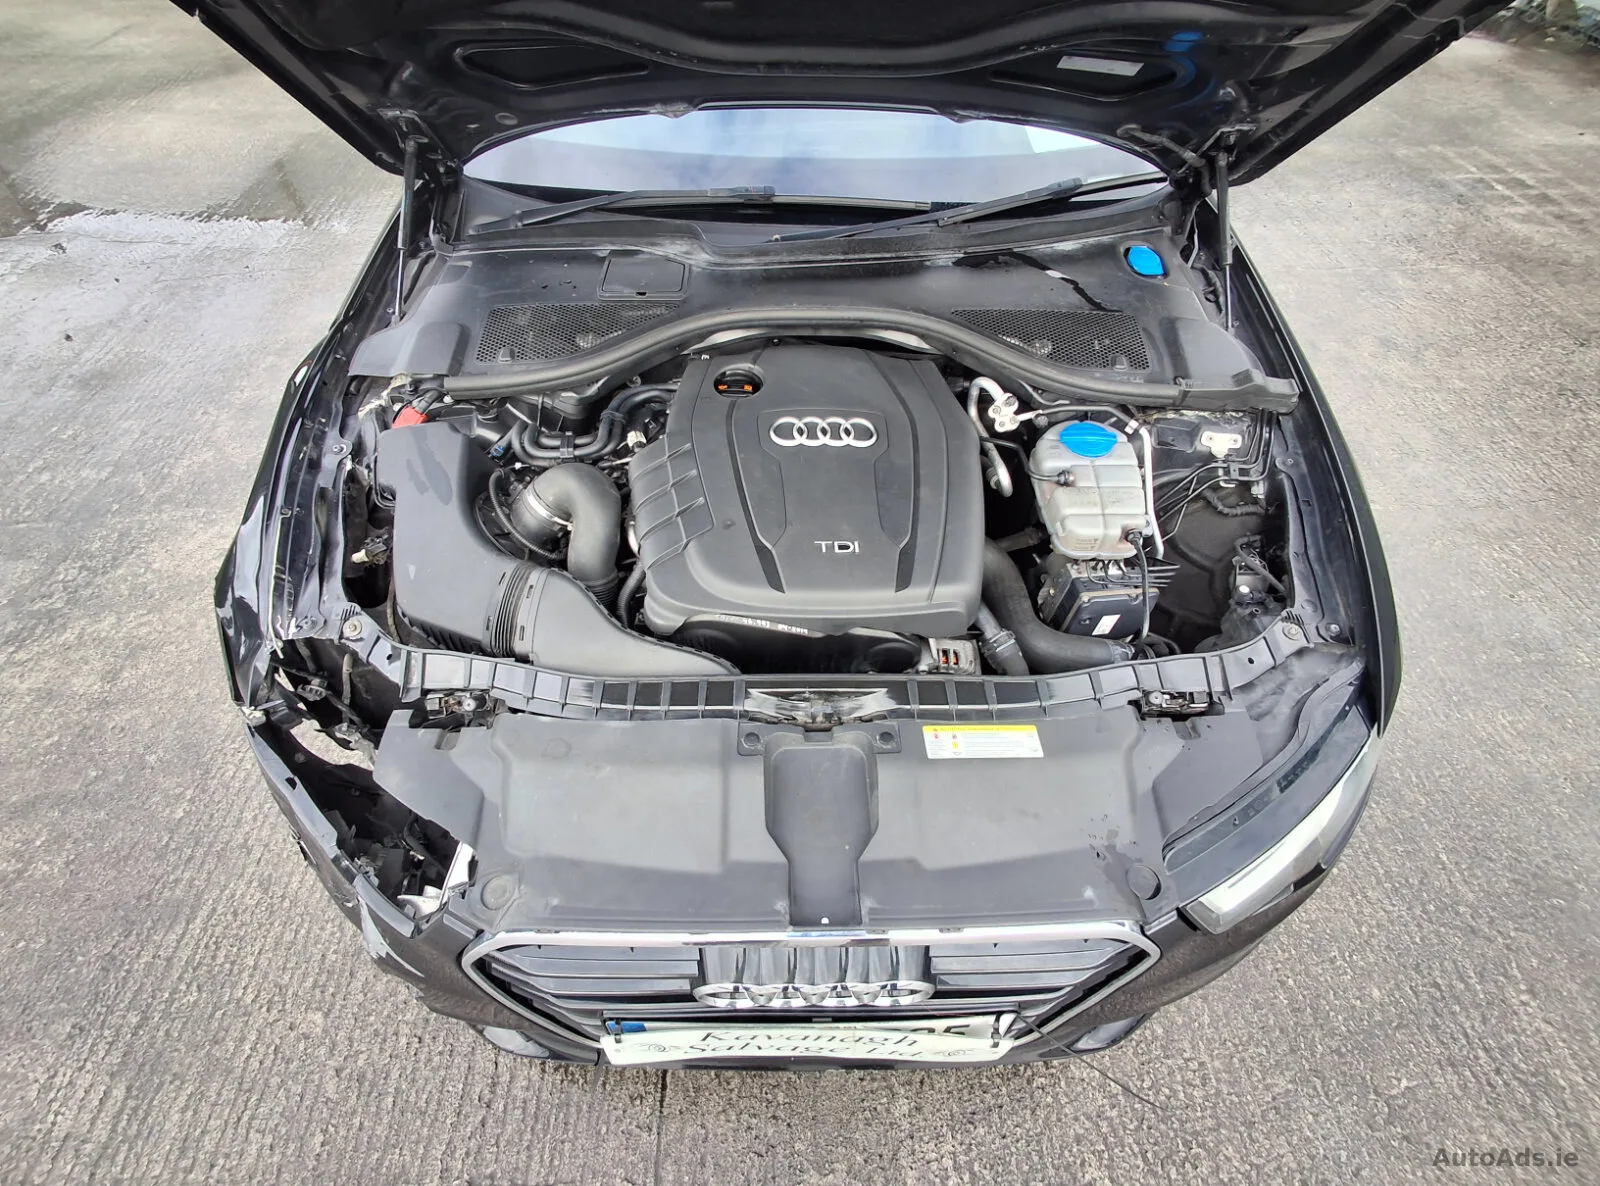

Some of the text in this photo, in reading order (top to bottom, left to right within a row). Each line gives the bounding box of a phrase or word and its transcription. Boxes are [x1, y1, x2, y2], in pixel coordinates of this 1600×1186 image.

[814, 541, 859, 552] TDI
[701, 1031, 919, 1046] Kavanagh
[685, 1042, 850, 1053] Salvage
